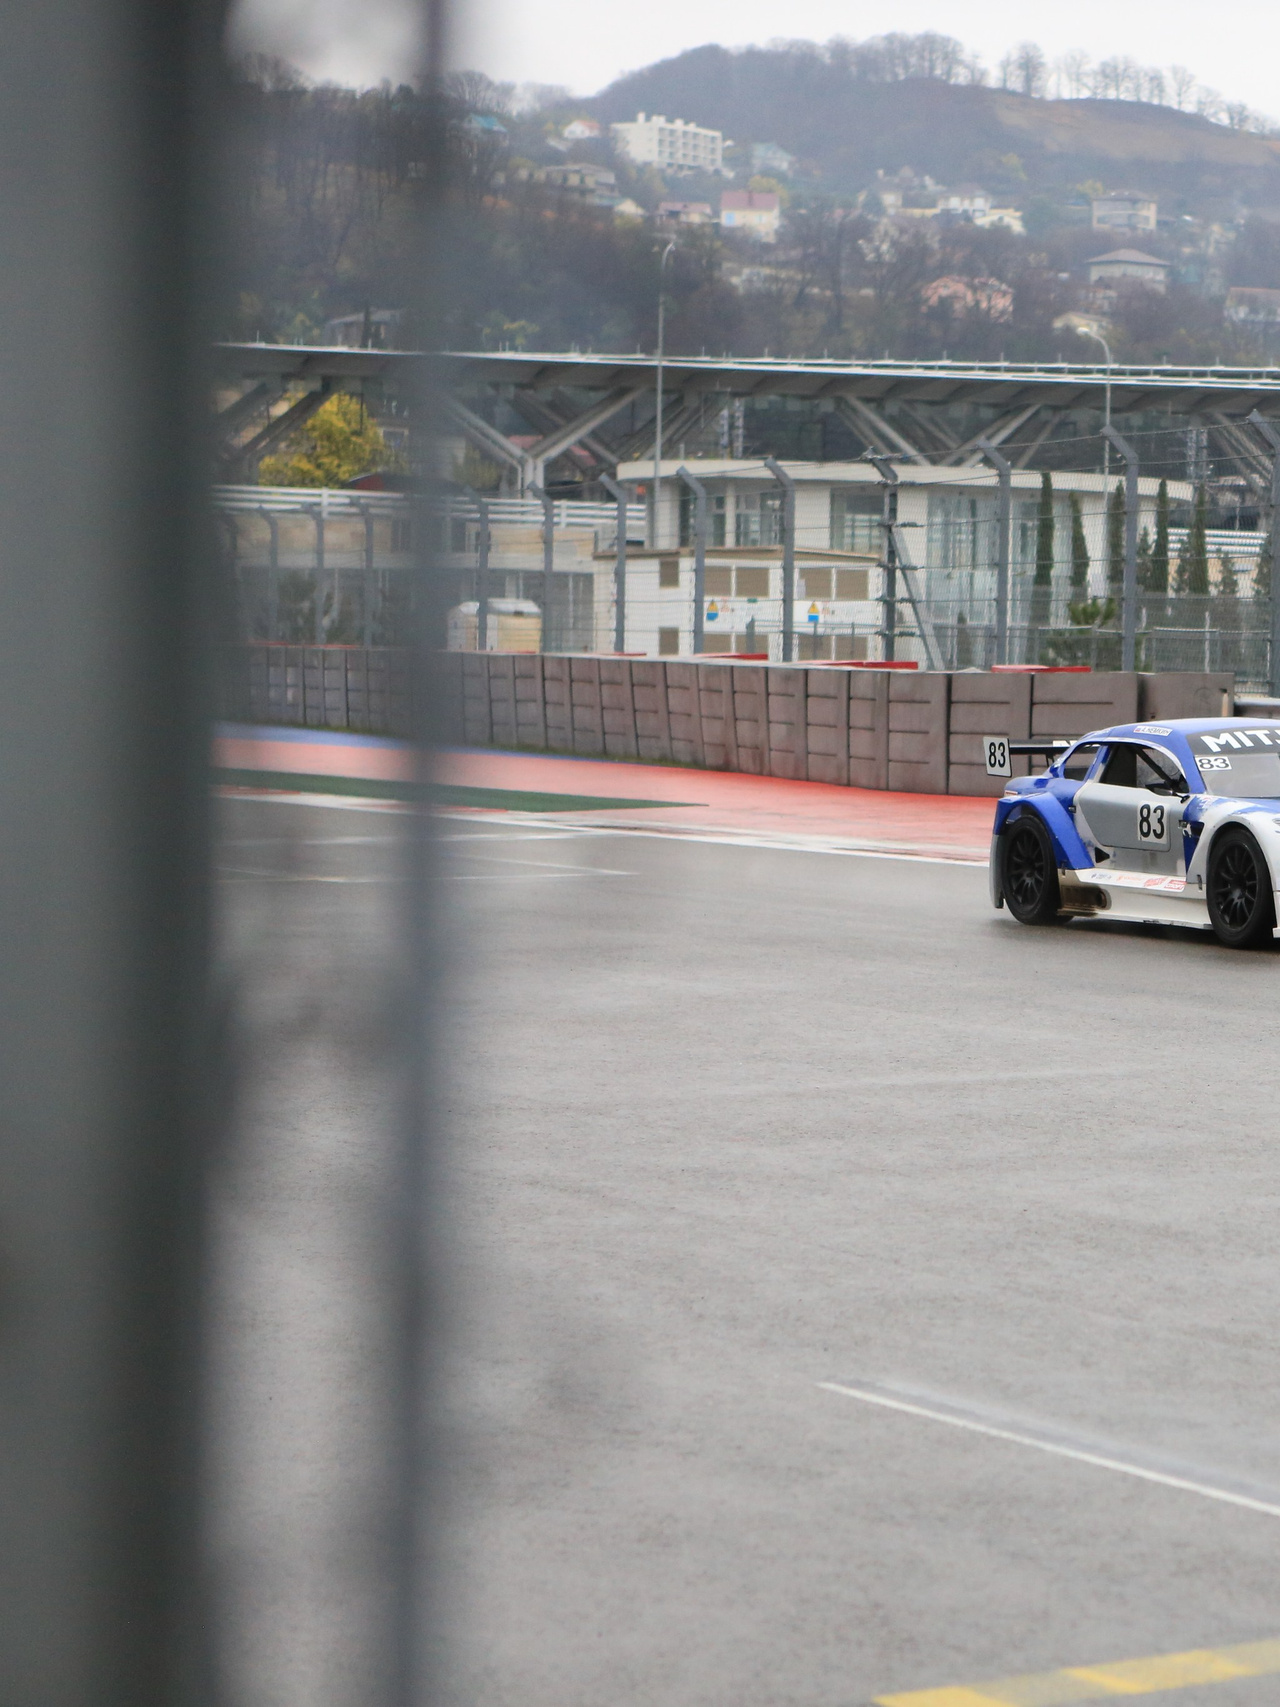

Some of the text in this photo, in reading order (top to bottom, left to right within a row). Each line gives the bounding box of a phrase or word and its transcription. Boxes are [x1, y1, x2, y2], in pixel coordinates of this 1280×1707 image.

[988, 741, 1006, 768] 83
[1199, 757, 1230, 770] 83
[1139, 803, 1165, 840] 83
